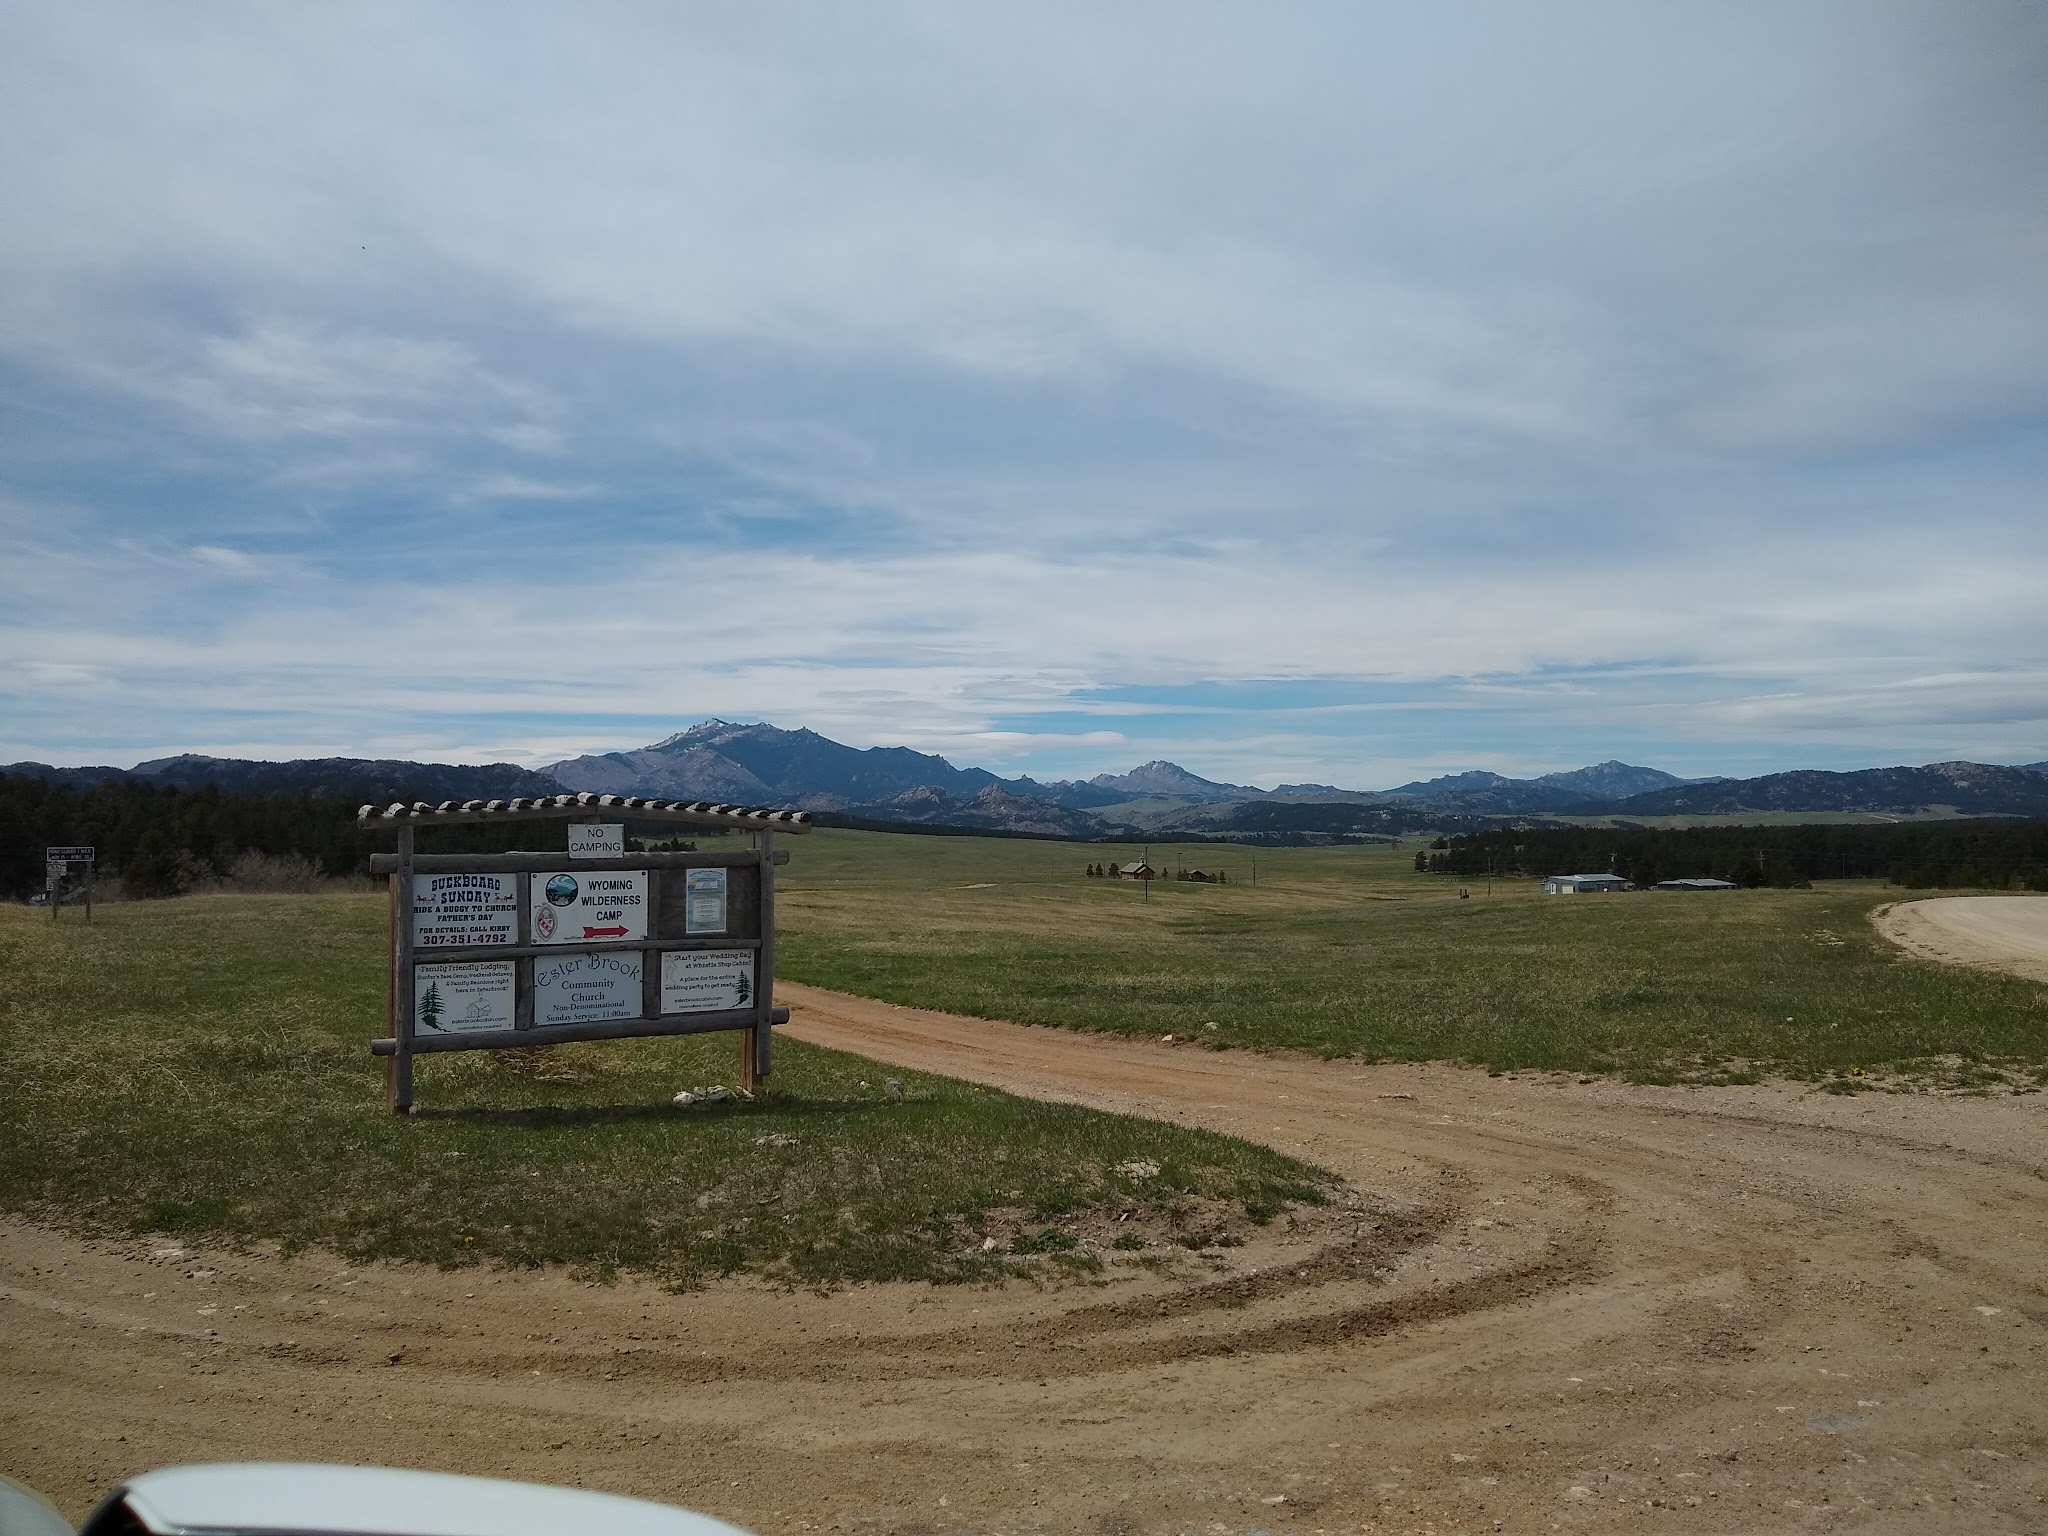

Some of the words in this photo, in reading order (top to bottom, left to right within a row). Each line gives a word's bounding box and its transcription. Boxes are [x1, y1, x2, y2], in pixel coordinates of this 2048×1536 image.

[588, 829, 604, 837] NO
[571, 842, 621, 851] CAMPING
[432, 876, 500, 891] BUCKBOARD
[588, 880, 633, 890] WYOMING
[441, 891, 491, 904] SUNDAY
[581, 895, 641, 906] WILDERNESS
[596, 910, 622, 921] CAMP
[423, 934, 506, 944] 307-351-4792
[588, 953, 640, 980] Brook
[562, 979, 615, 989] Community
[572, 992, 605, 1002] Church
[553, 1000, 625, 1011] Non-Denominational
